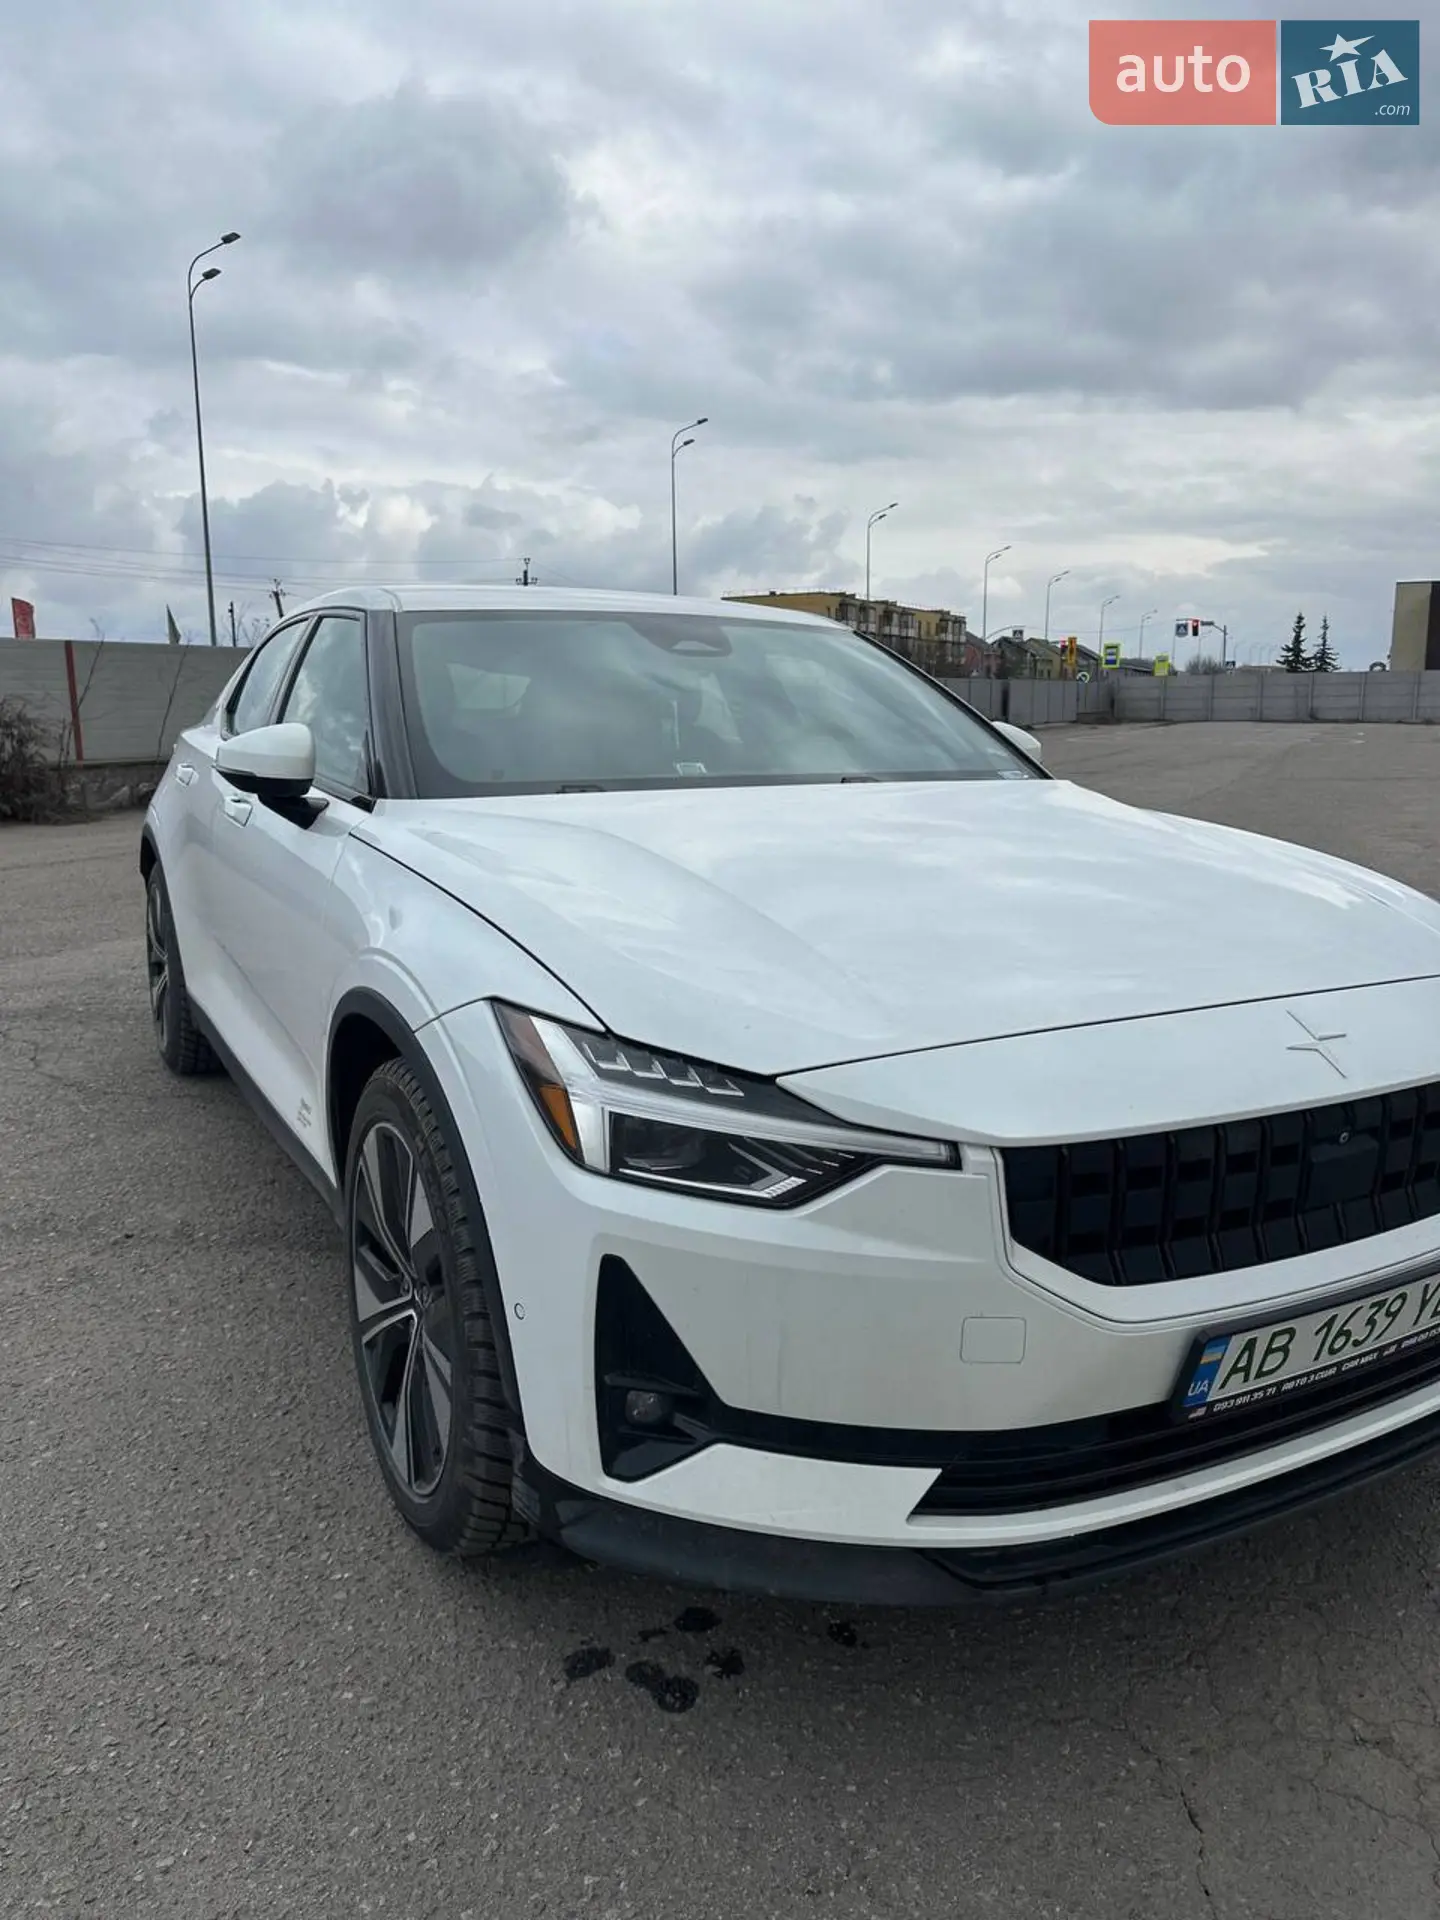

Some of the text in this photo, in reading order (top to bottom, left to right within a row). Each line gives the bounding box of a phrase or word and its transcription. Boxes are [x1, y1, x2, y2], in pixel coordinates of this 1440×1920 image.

[1219, 1326, 1297, 1390] AB
[1313, 1291, 1408, 1361] 1639
[1187, 1379, 1209, 1397] UA
